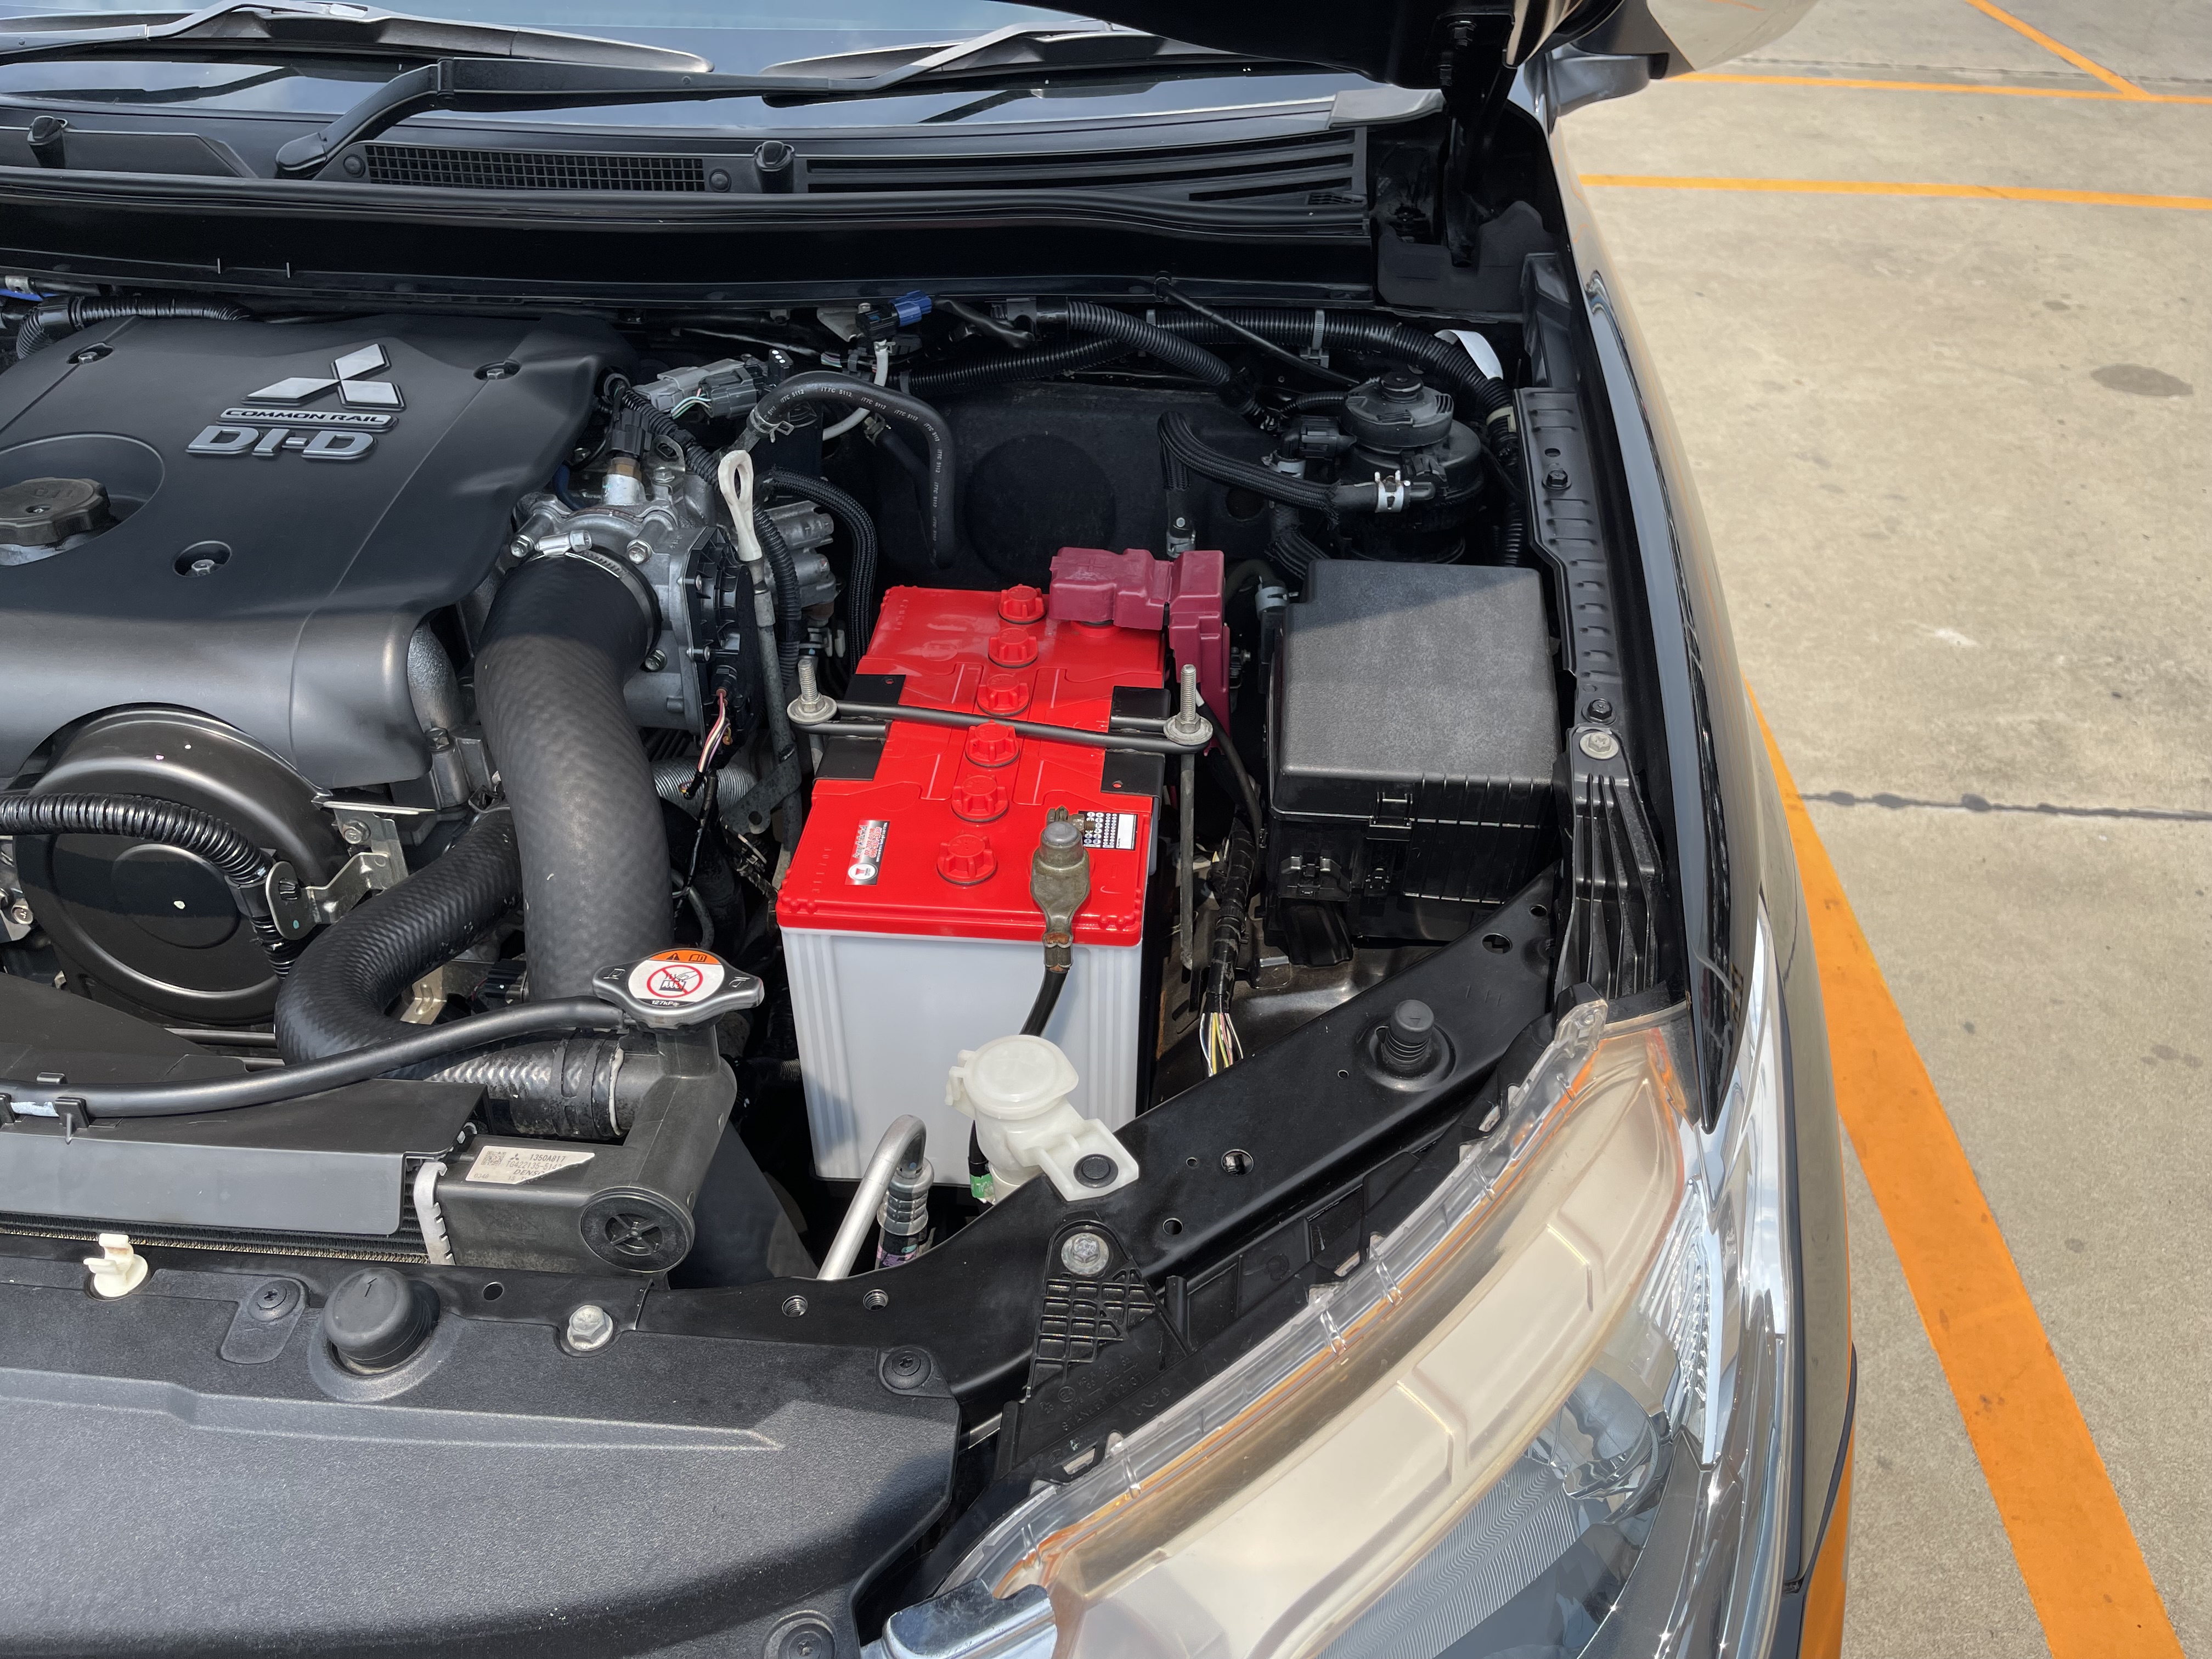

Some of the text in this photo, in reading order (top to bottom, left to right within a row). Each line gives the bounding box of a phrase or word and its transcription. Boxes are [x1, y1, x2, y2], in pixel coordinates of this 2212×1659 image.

[792, 389, 804, 397] 5112
[225, 410, 385, 423] COMMON RAIL
[186, 426, 376, 459] DI-D
[529, 1154, 566, 1163] 1350A817
